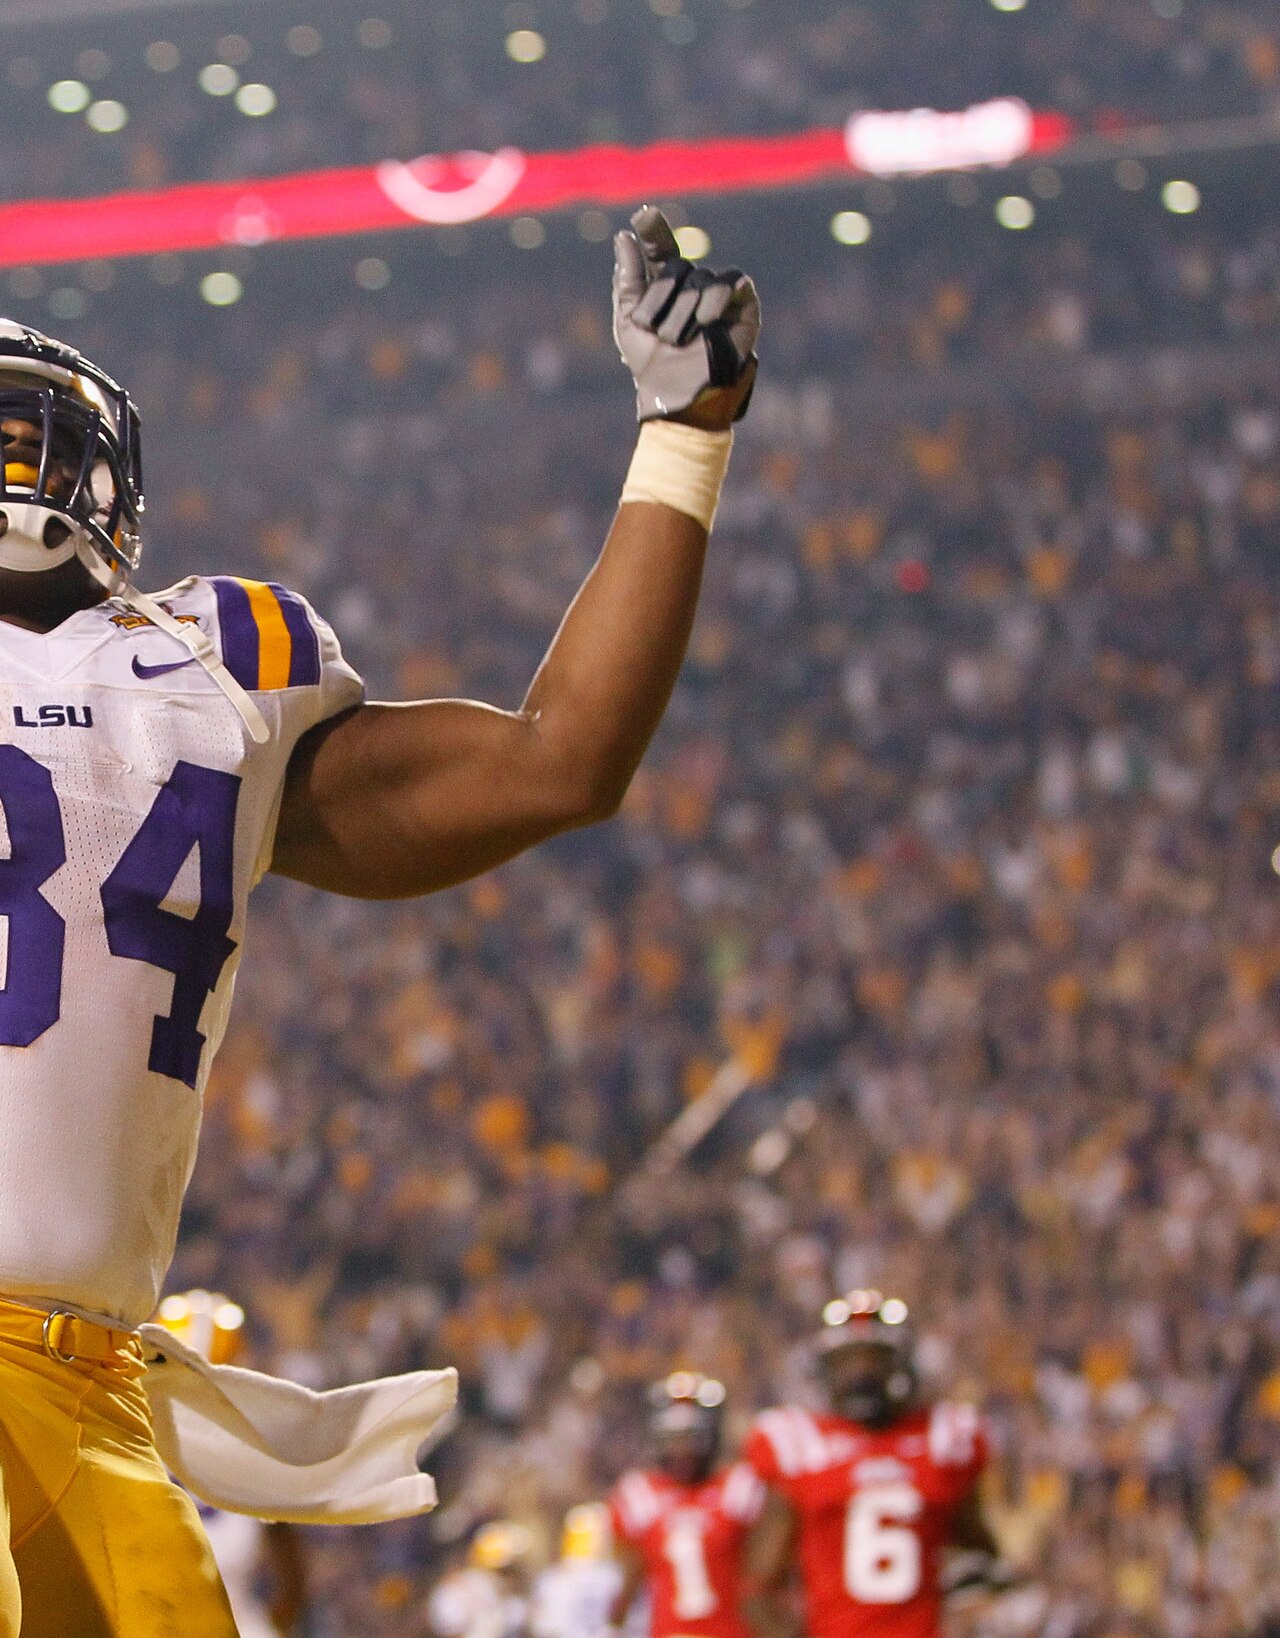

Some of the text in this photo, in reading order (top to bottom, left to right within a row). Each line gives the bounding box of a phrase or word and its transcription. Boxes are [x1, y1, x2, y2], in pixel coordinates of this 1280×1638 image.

[13, 705, 94, 729] LSU
[662, 1508, 717, 1621] 1
[843, 1483, 925, 1605] 6
